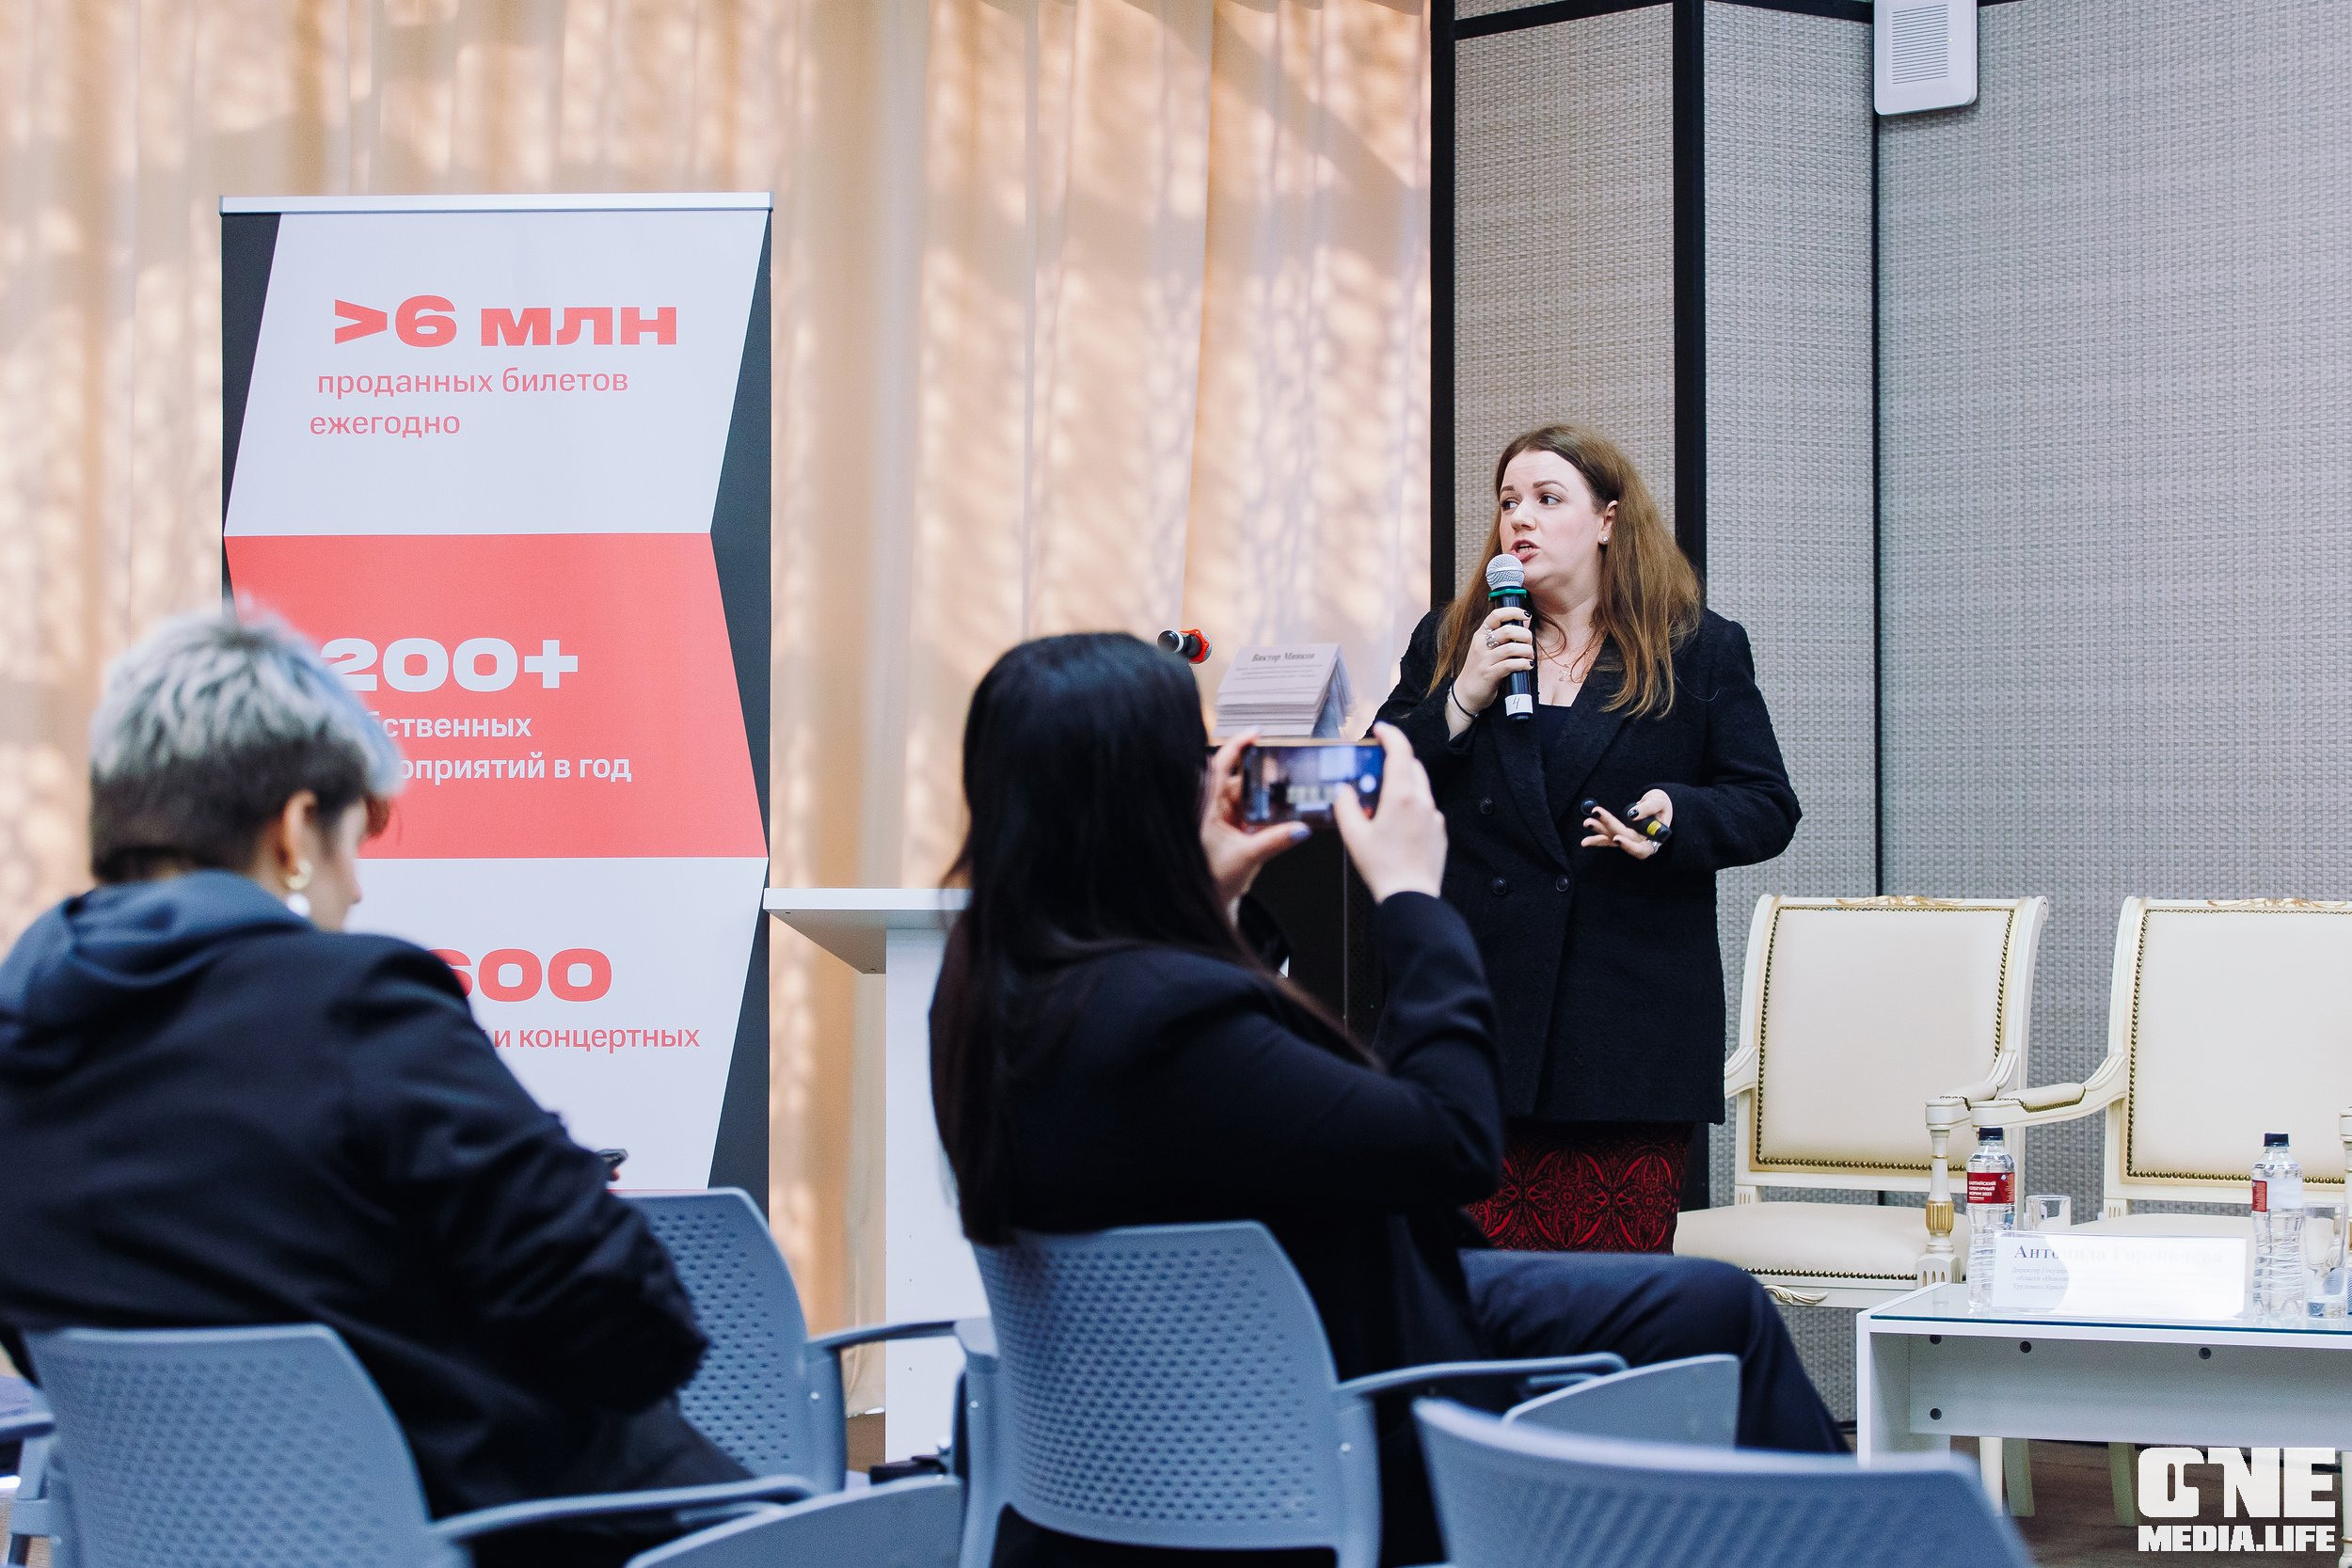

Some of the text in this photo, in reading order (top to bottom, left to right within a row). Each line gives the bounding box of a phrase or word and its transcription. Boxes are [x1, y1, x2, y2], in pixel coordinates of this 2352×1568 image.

[335, 294, 677, 348] >6 млн
[318, 367, 628, 399] проданных билетов
[310, 414, 461, 438] ежегодно
[321, 638, 578, 692] 200+
[368, 711, 532, 738] ственных
[399, 752, 632, 785] оприятий в год
[494, 1029, 700, 1053] и концертных
